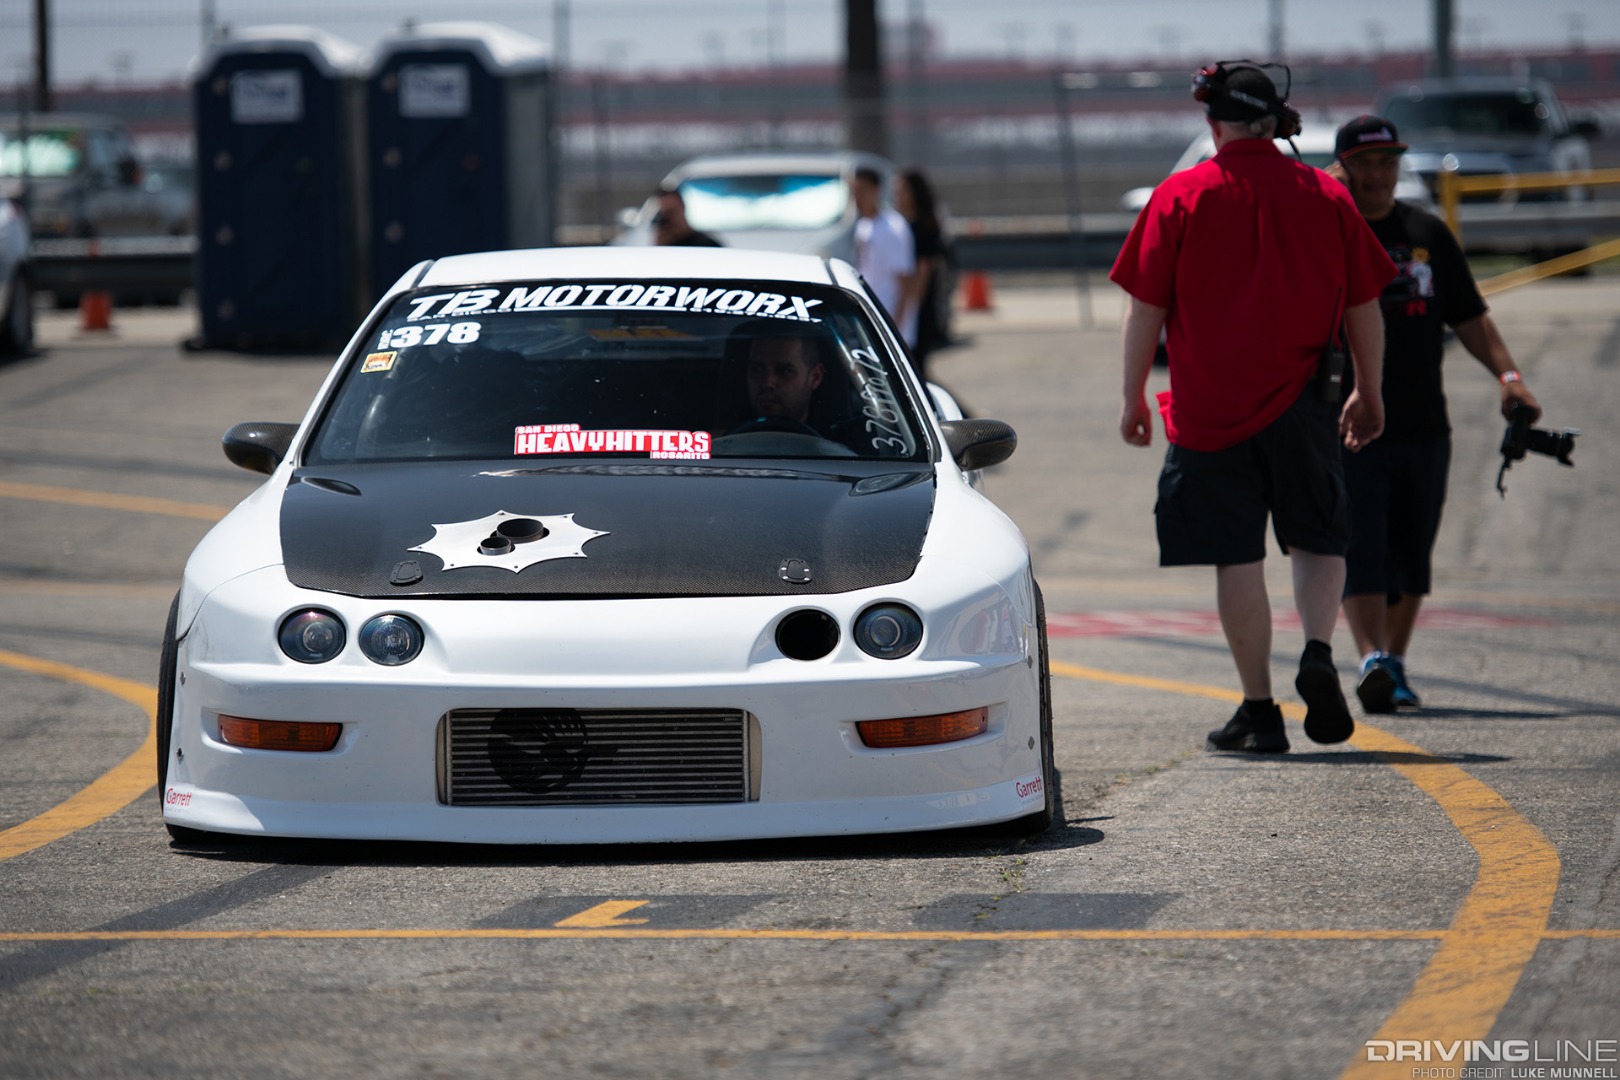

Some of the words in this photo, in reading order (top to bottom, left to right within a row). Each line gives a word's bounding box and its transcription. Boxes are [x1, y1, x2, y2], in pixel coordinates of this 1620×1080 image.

[407, 289, 501, 319] TB
[498, 284, 823, 318] MOTORWORX
[390, 322, 482, 348] 378
[517, 425, 542, 434] SAN
[544, 423, 580, 432] DIEGO
[517, 431, 710, 454] HEAVYHITTERS
[652, 451, 711, 460] ROSARITO
[166, 788, 192, 806] Garrett
[1015, 776, 1043, 798] Garrett
